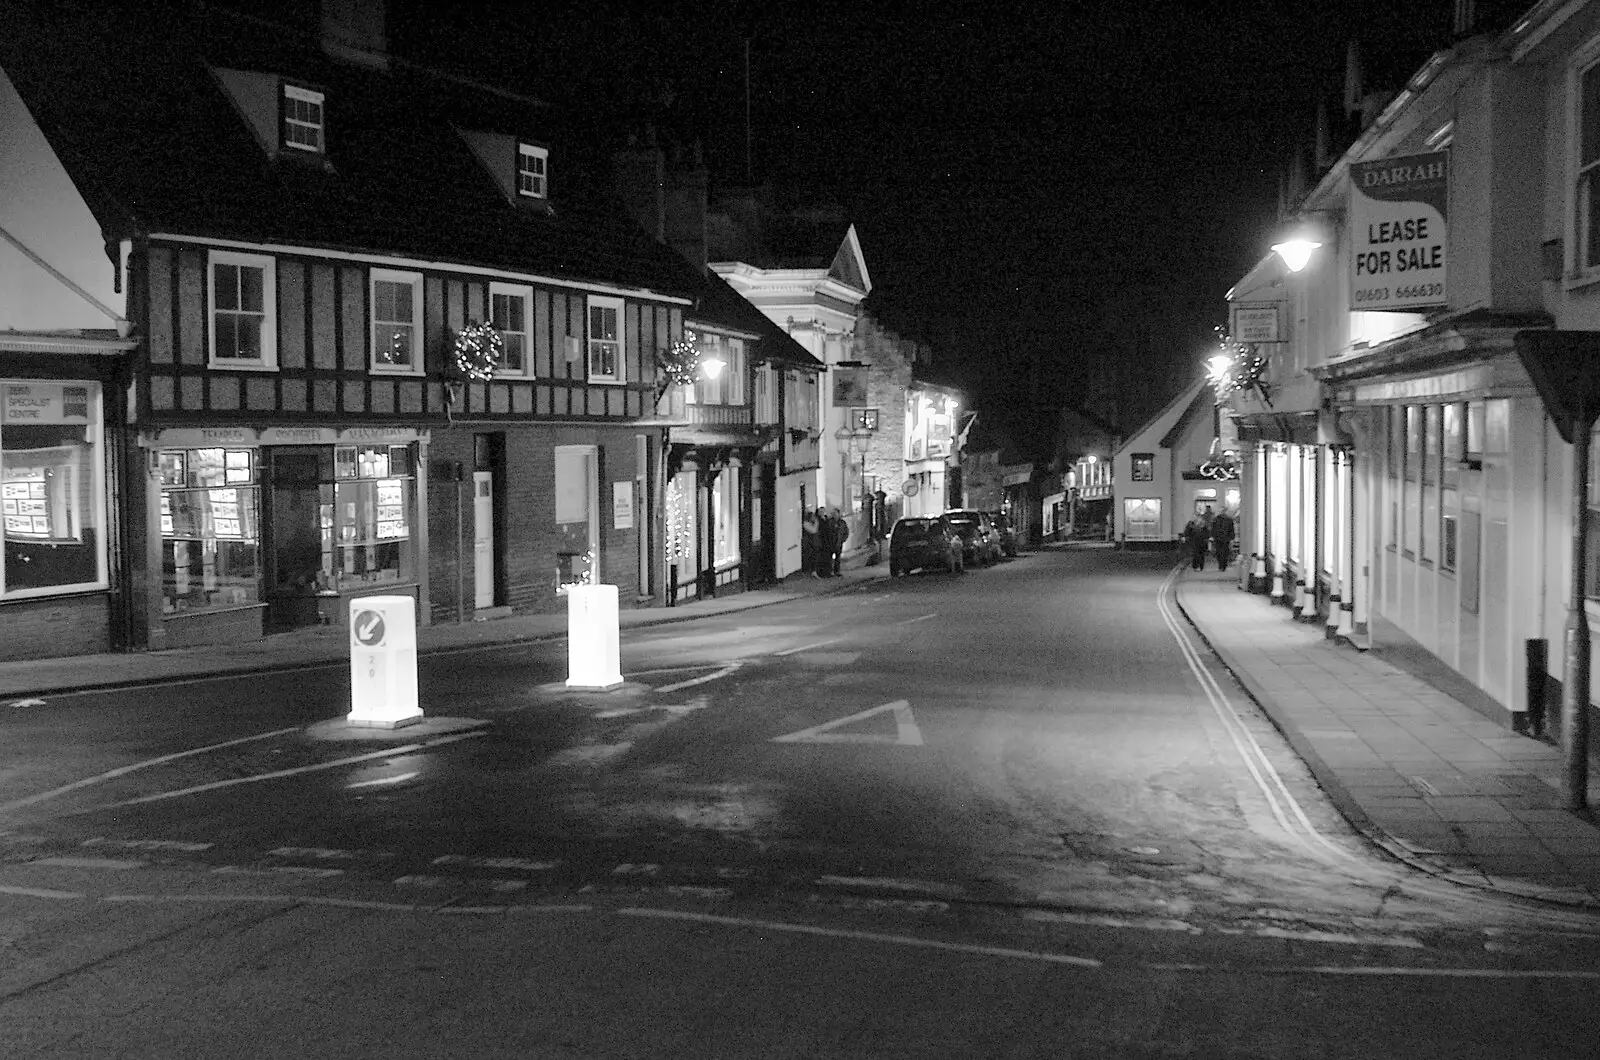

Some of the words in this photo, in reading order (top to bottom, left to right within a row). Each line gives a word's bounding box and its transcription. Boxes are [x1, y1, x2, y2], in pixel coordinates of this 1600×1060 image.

[1368, 217, 1428, 244] LEASE
[1356, 250, 1391, 276] FOR
[1396, 245, 1443, 272] SALE
[9, 409, 41, 419] CENTRE
